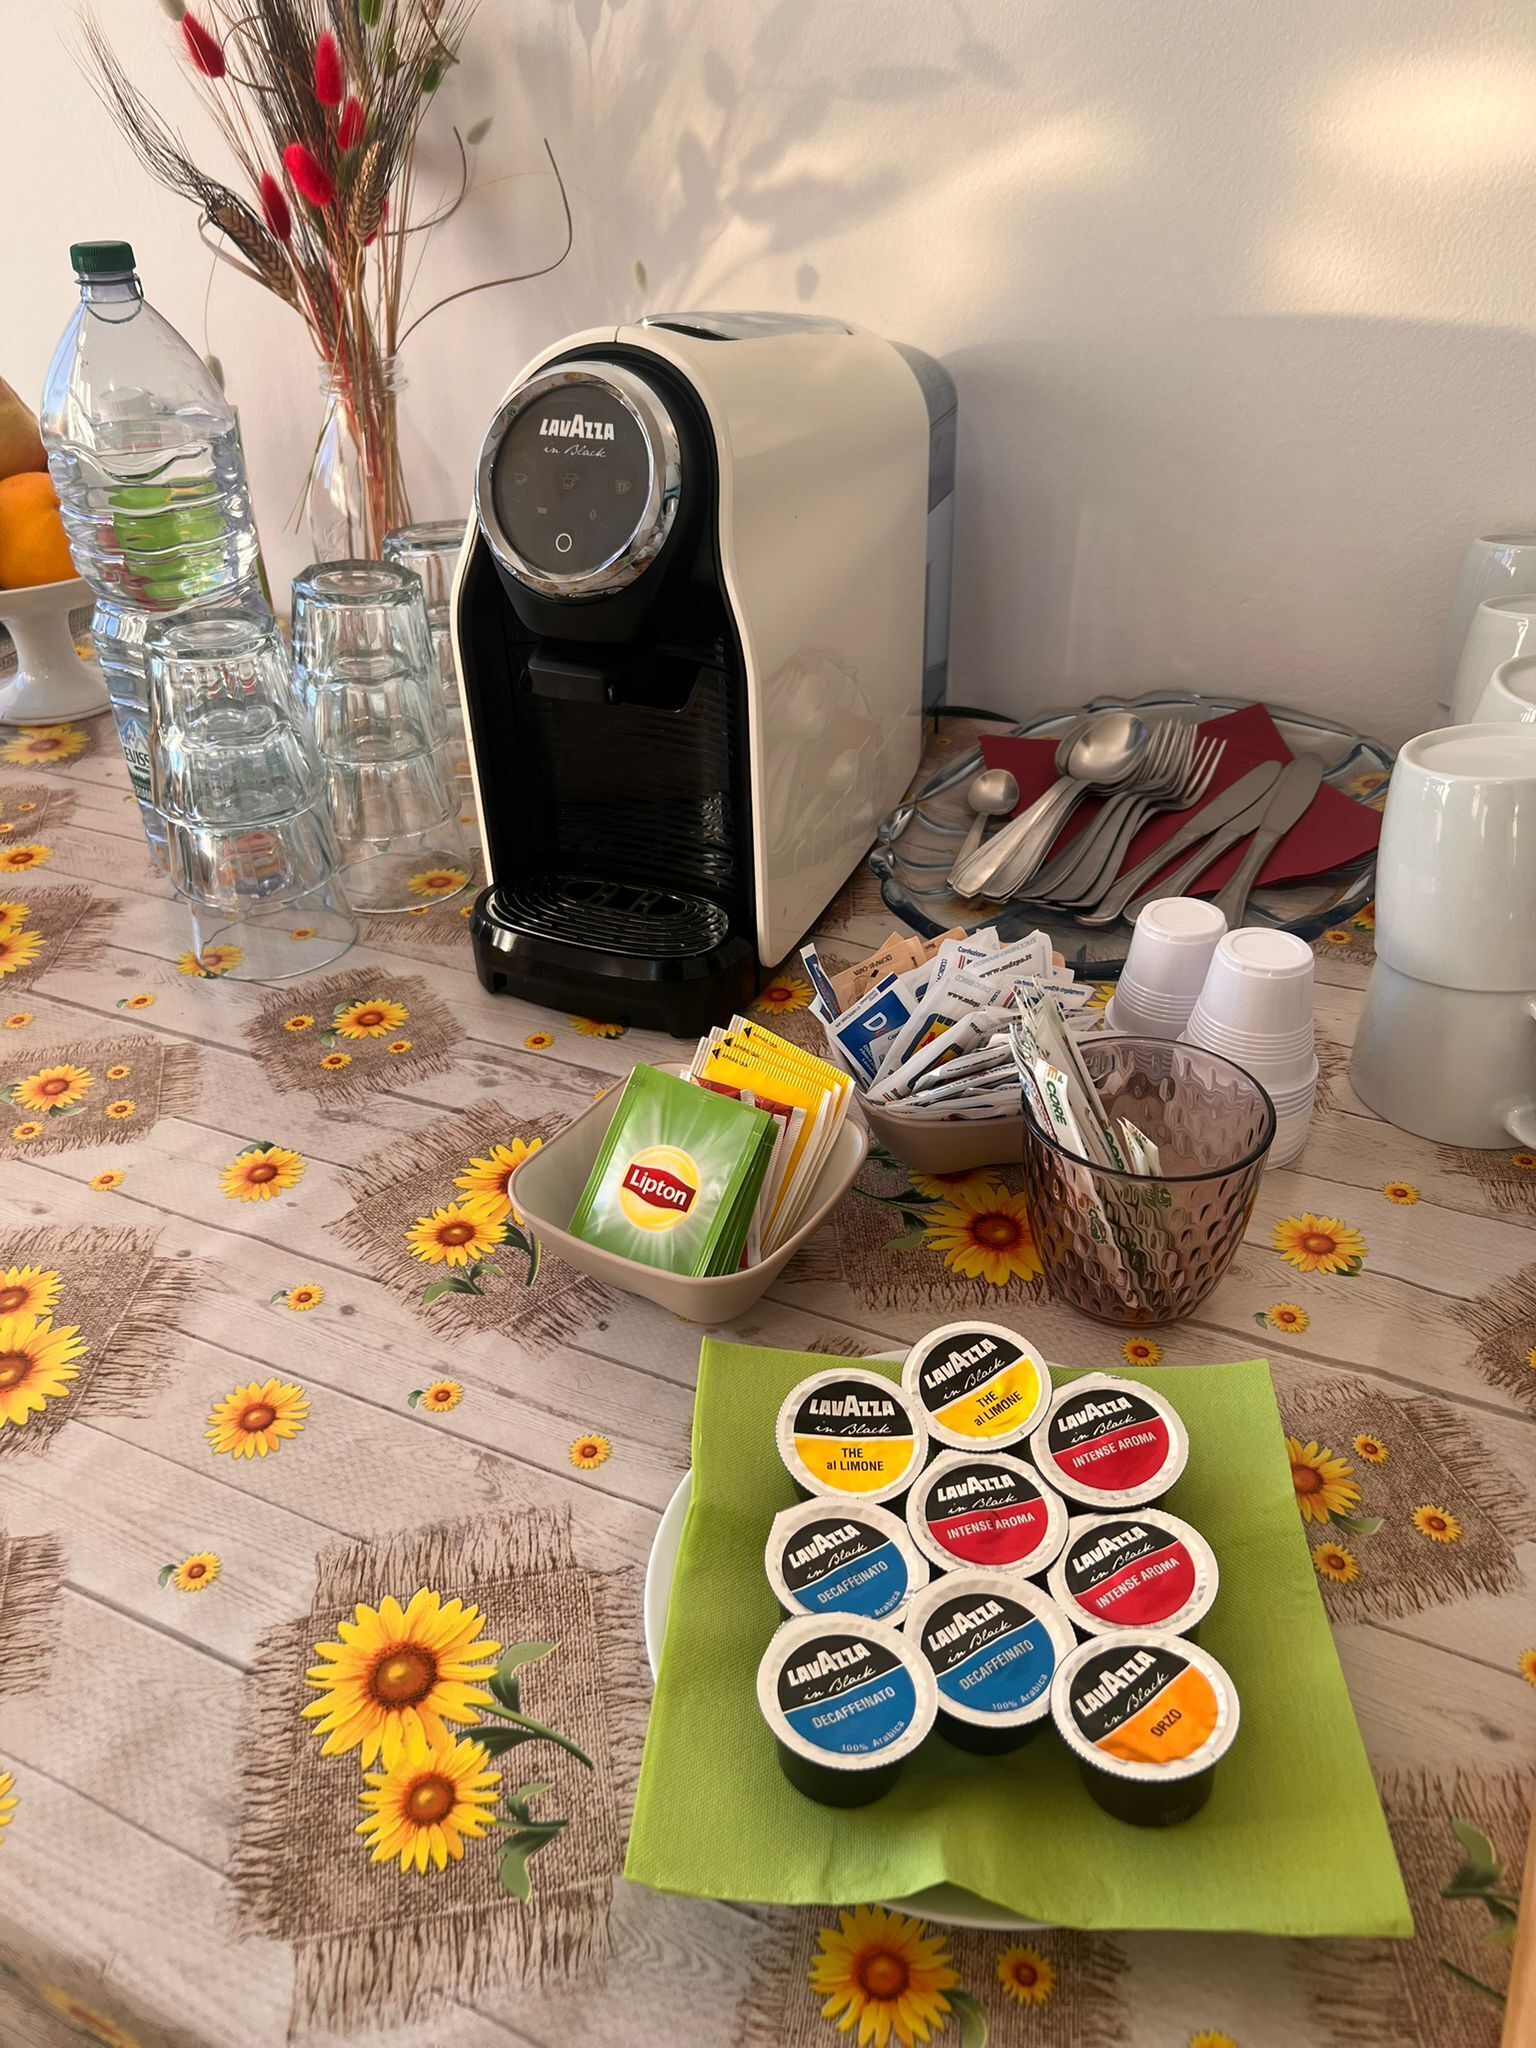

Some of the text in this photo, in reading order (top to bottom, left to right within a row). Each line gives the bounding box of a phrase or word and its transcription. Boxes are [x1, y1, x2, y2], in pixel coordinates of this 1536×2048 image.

[539, 414, 615, 441] LAVAZZA
[543, 443, 607, 458] in Black
[1046, 1080, 1067, 1126] CORE
[629, 1168, 688, 1206] Lipton
[922, 1337, 998, 1389] LAVAZZA
[942, 1359, 1006, 1400] in Black
[809, 1395, 895, 1417] LAVAZZA
[974, 1391, 1023, 1427] al LIMONE
[976, 1390, 999, 1408] THE
[1057, 1396, 1133, 1432] LAVAZZA
[814, 1421, 892, 1435] in Black
[1070, 1414, 1137, 1444] in Black
[826, 1460, 884, 1471] al LIMONE
[842, 1448, 863, 1458] THE
[1072, 1431, 1157, 1468] INTENSE AROMA
[937, 1474, 1016, 1503] LAVAZZA
[947, 1493, 1017, 1514] in Black
[947, 1512, 1035, 1540] INTENSE AROMA
[788, 1524, 861, 1569] LAVAZZA
[806, 1543, 868, 1580] in Black
[1072, 1526, 1148, 1574] LAVAZZA
[1089, 1542, 1155, 1583] in Black
[817, 1560, 888, 1604] DECAFFEINATO
[1096, 1556, 1180, 1609] INTENSE AROMA
[874, 1590, 901, 1616] Arabica
[927, 1600, 1004, 1651] LAVAZZA
[947, 1620, 1012, 1663] in Black
[787, 1642, 871, 1687] LAVAZZA
[803, 1664, 876, 1701] in Black
[959, 1639, 1034, 1690] DECAFFEINATO
[992, 1673, 1048, 1710] 100% Arabica
[1075, 1650, 1157, 1717] LAVAZZA
[1103, 1671, 1169, 1729] in Black
[812, 1686, 896, 1729] DECAFFEINATO
[1151, 1708, 1182, 1738] ORZO
[841, 1720, 905, 1752] 100% Arabica
